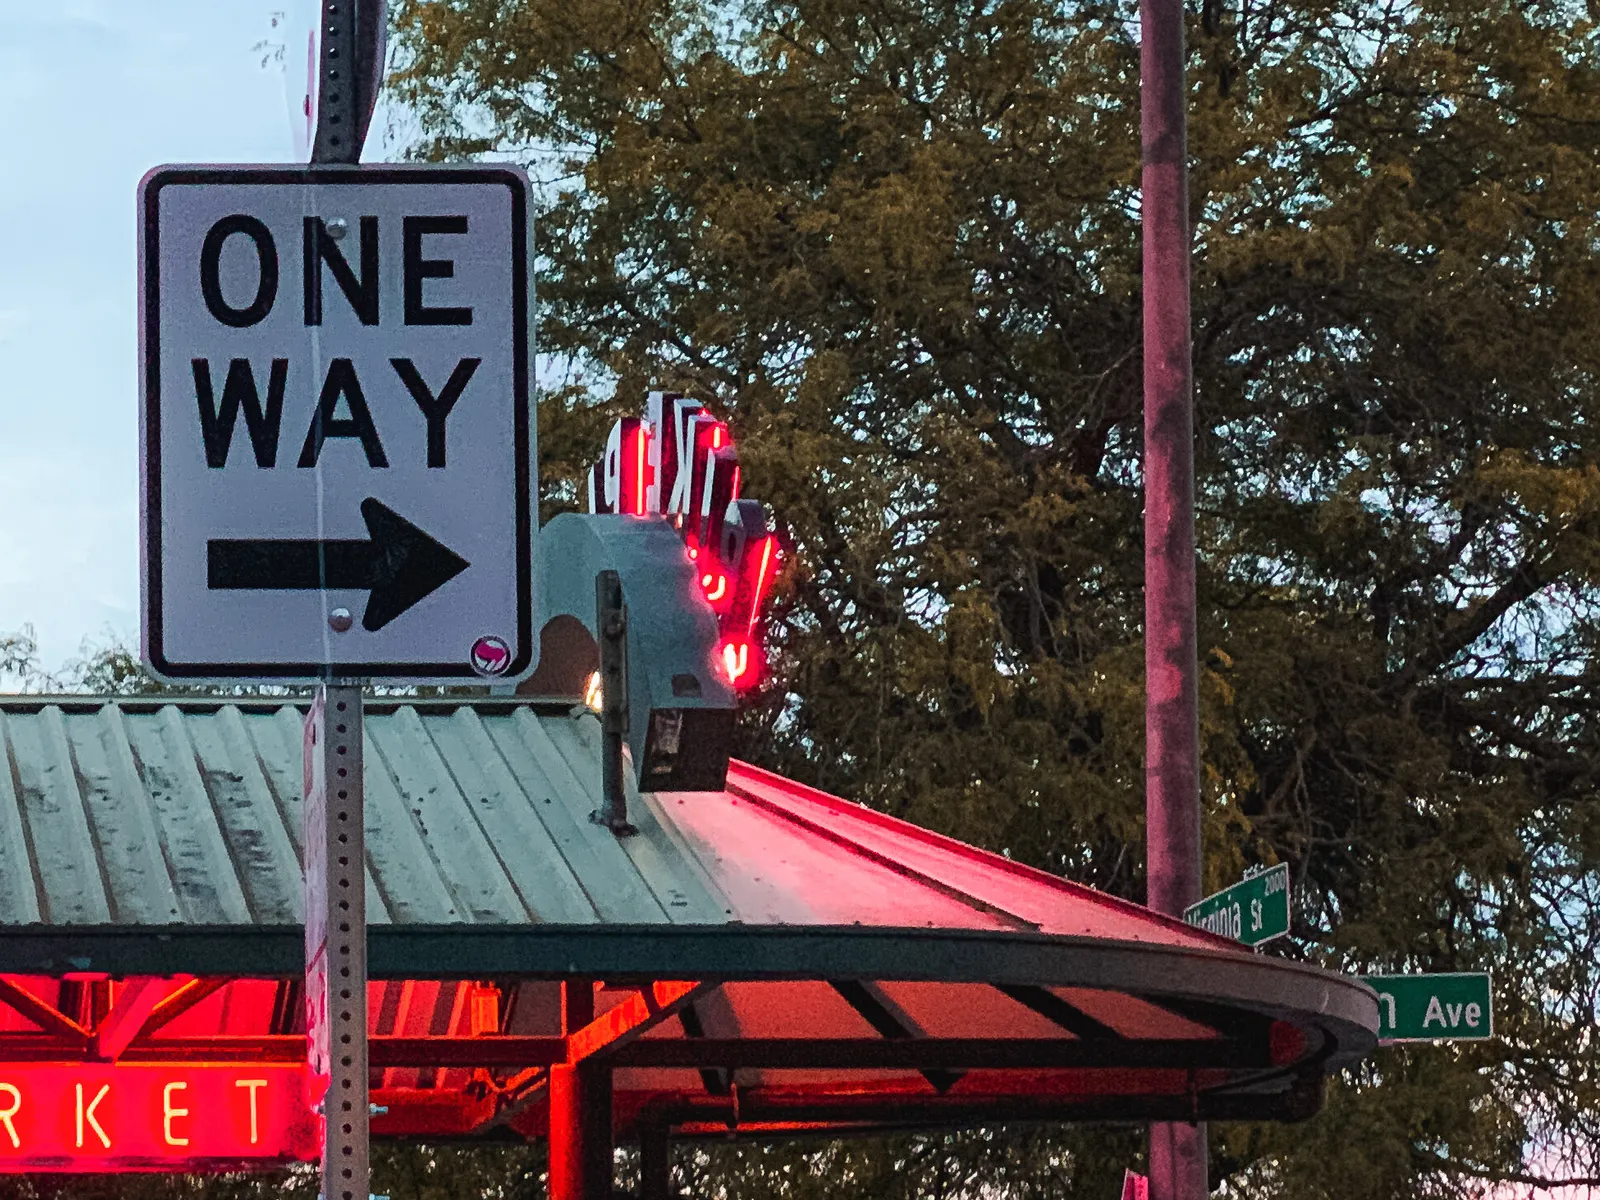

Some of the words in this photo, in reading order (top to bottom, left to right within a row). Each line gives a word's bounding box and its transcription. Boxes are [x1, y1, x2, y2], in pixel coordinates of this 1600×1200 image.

[200, 213, 474, 328] ONE
[191, 357, 482, 469] WAY
[1264, 870, 1285, 896] 2000
[1187, 893, 1241, 940] ginia
[1250, 898, 1263, 932] St
[1422, 995, 1481, 1028] Ave
